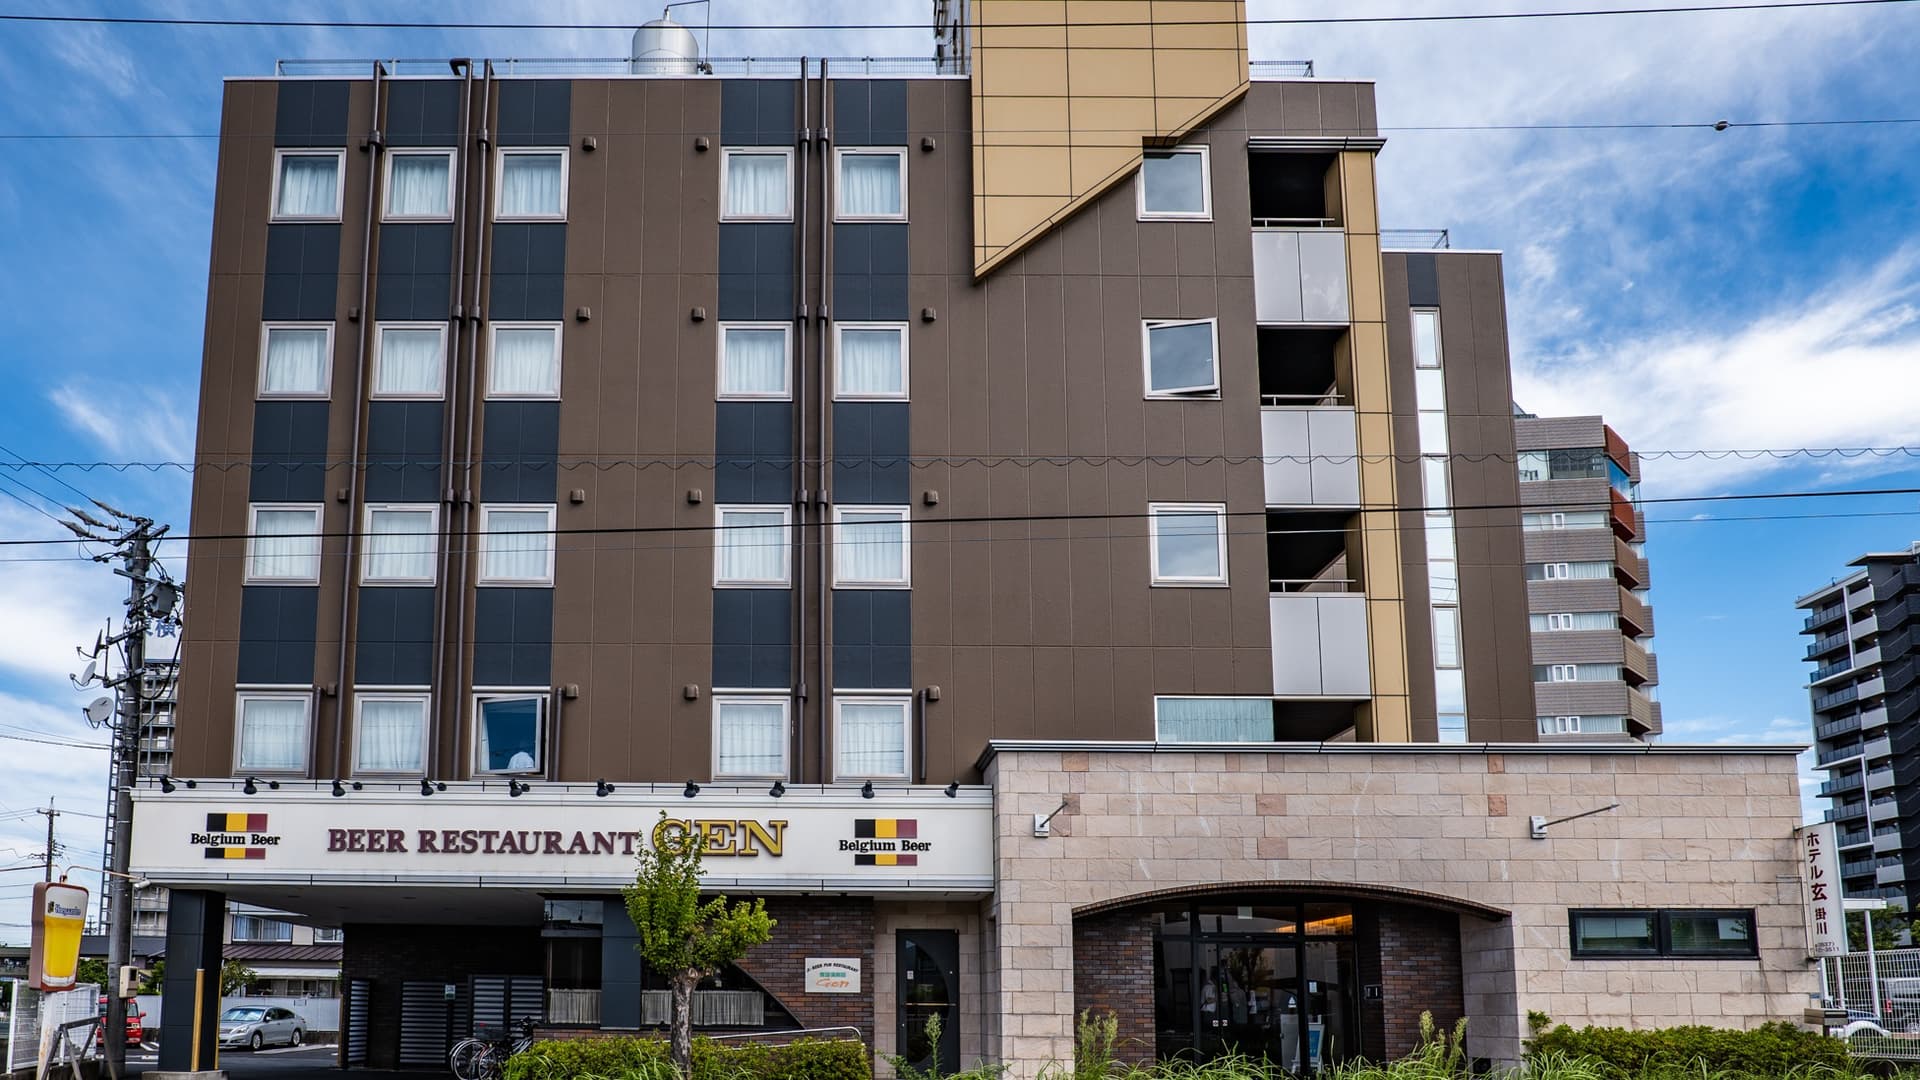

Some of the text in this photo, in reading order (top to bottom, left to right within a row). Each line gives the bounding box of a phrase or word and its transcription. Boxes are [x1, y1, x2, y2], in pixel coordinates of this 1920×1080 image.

[190, 833, 281, 847] Belgium Beer
[327, 818, 788, 857] BEER RESTAURANT GEN
[838, 839, 932, 853] Belgium Beer
[1815, 906, 1828, 935] 掛川
